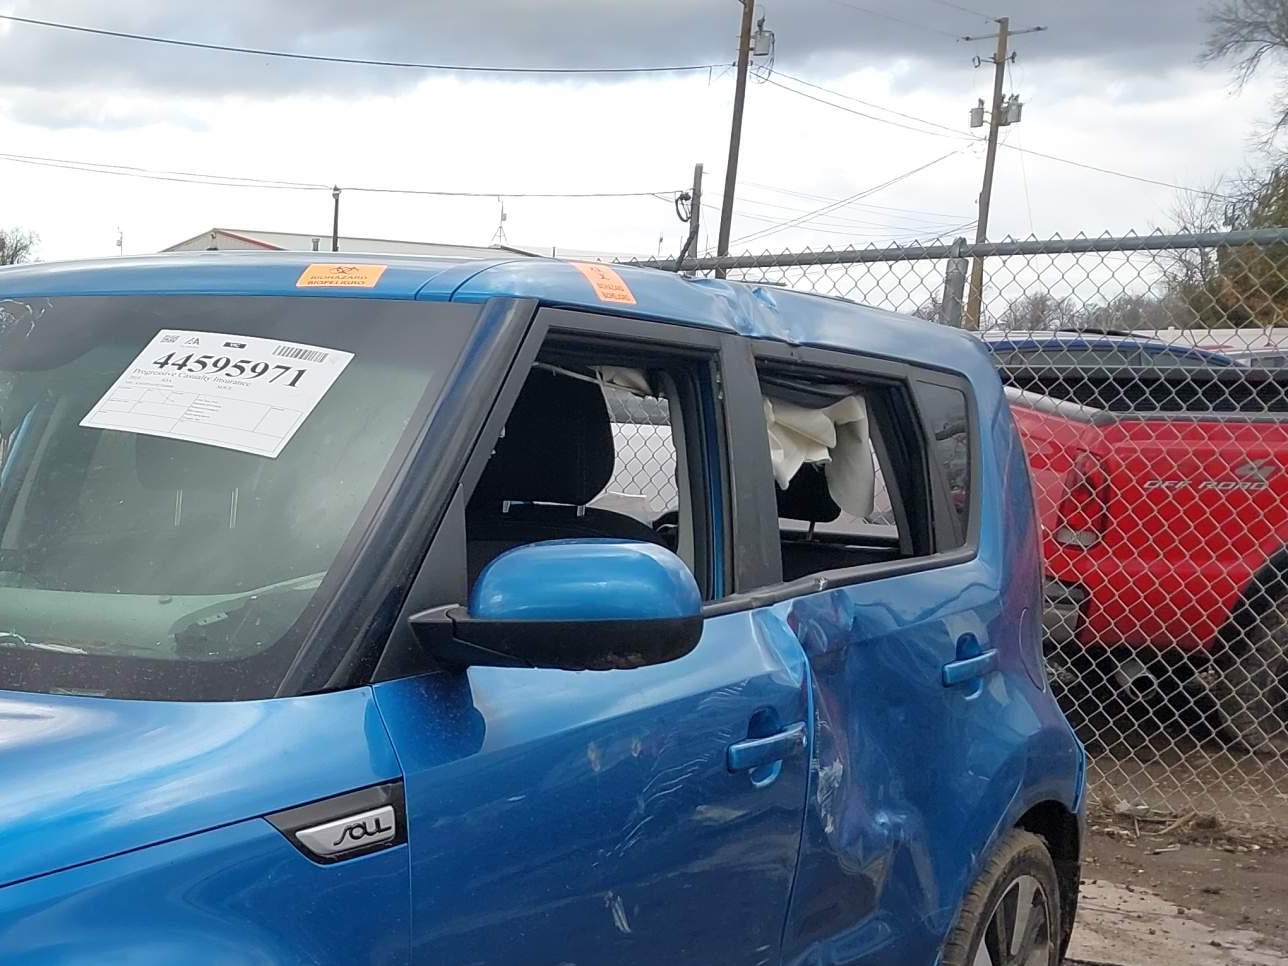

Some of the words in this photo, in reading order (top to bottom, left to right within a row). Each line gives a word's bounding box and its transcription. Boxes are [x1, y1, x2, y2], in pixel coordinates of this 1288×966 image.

[152, 352, 307, 387] 44595971
[178, 372, 210, 382] Casualty
[213, 376, 251, 387] Insurance
[1143, 480, 1190, 489] OFF
[1198, 481, 1268, 490] ROAD
[333, 818, 392, 846] SOUL
